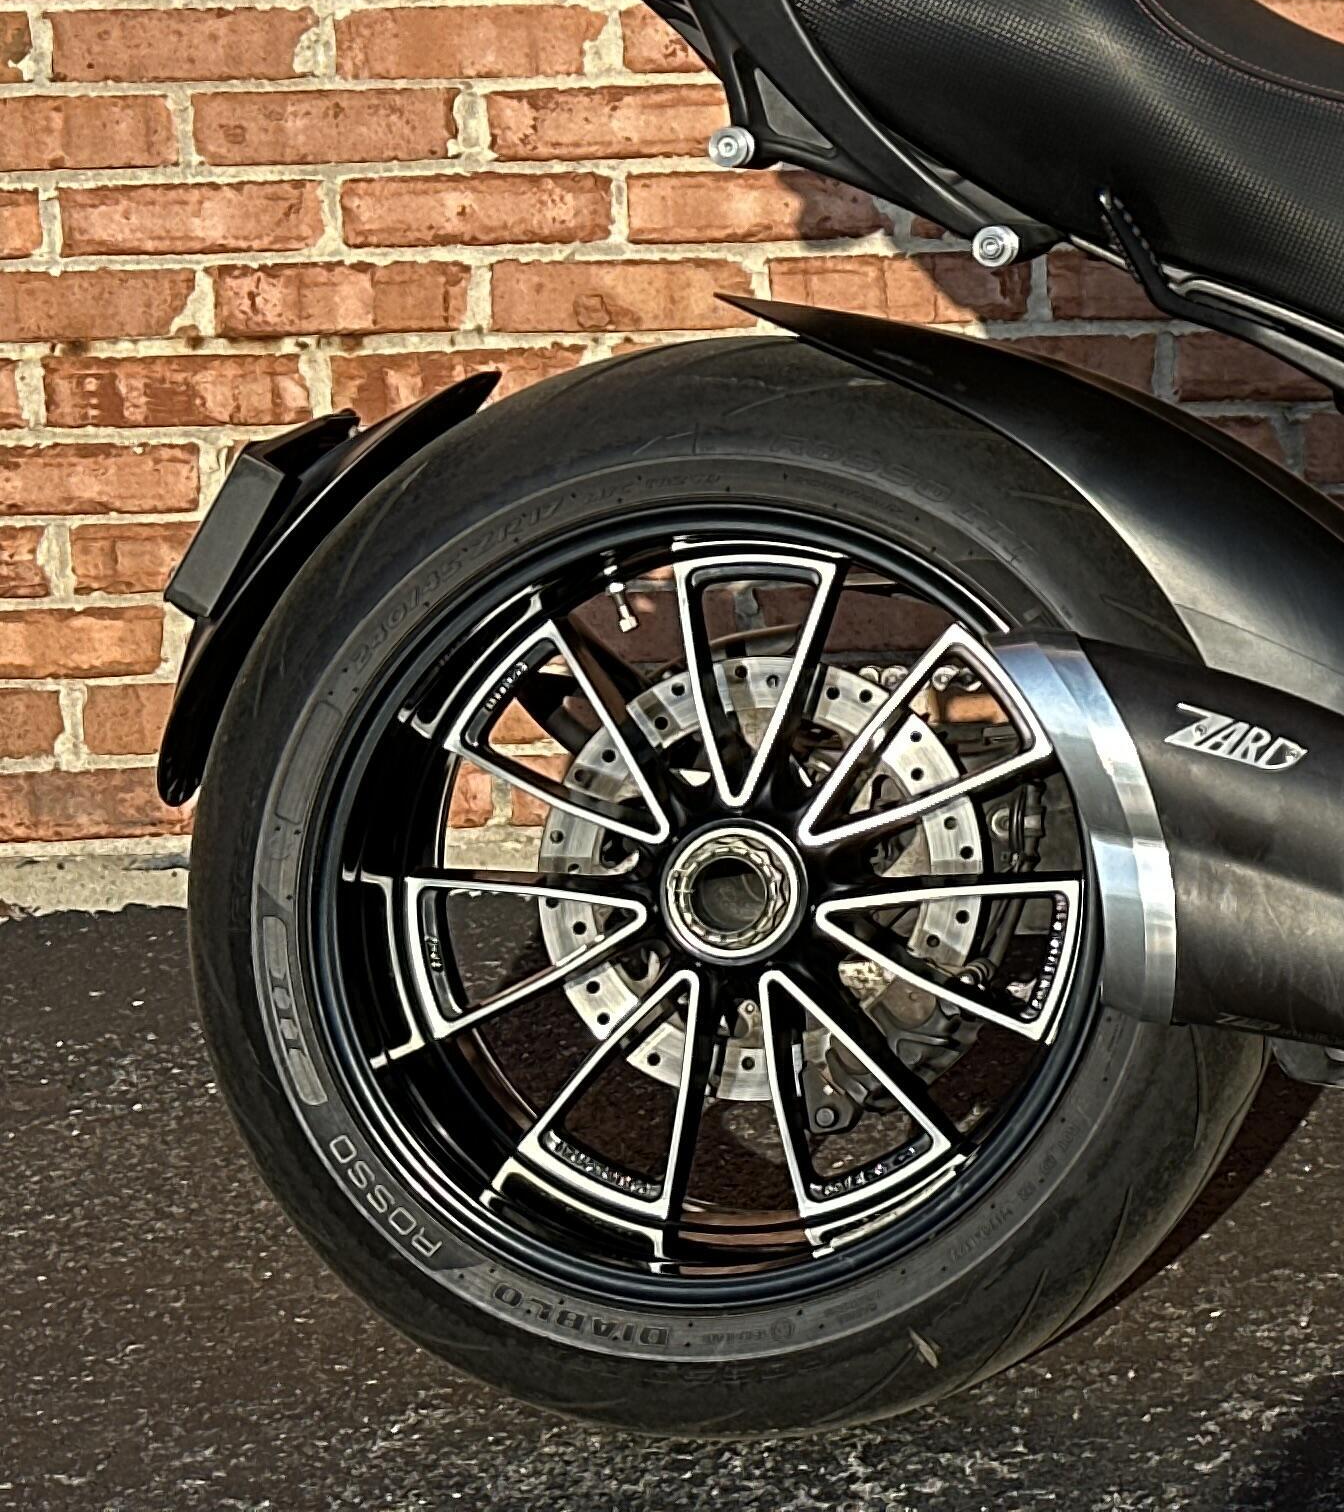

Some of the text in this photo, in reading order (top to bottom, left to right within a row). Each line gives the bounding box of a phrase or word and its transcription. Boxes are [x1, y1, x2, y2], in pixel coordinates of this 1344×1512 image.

[1164, 702, 1309, 771] ZARD
[328, 1133, 443, 1259] ROSSO
[494, 1285, 669, 1345] DIABLO
